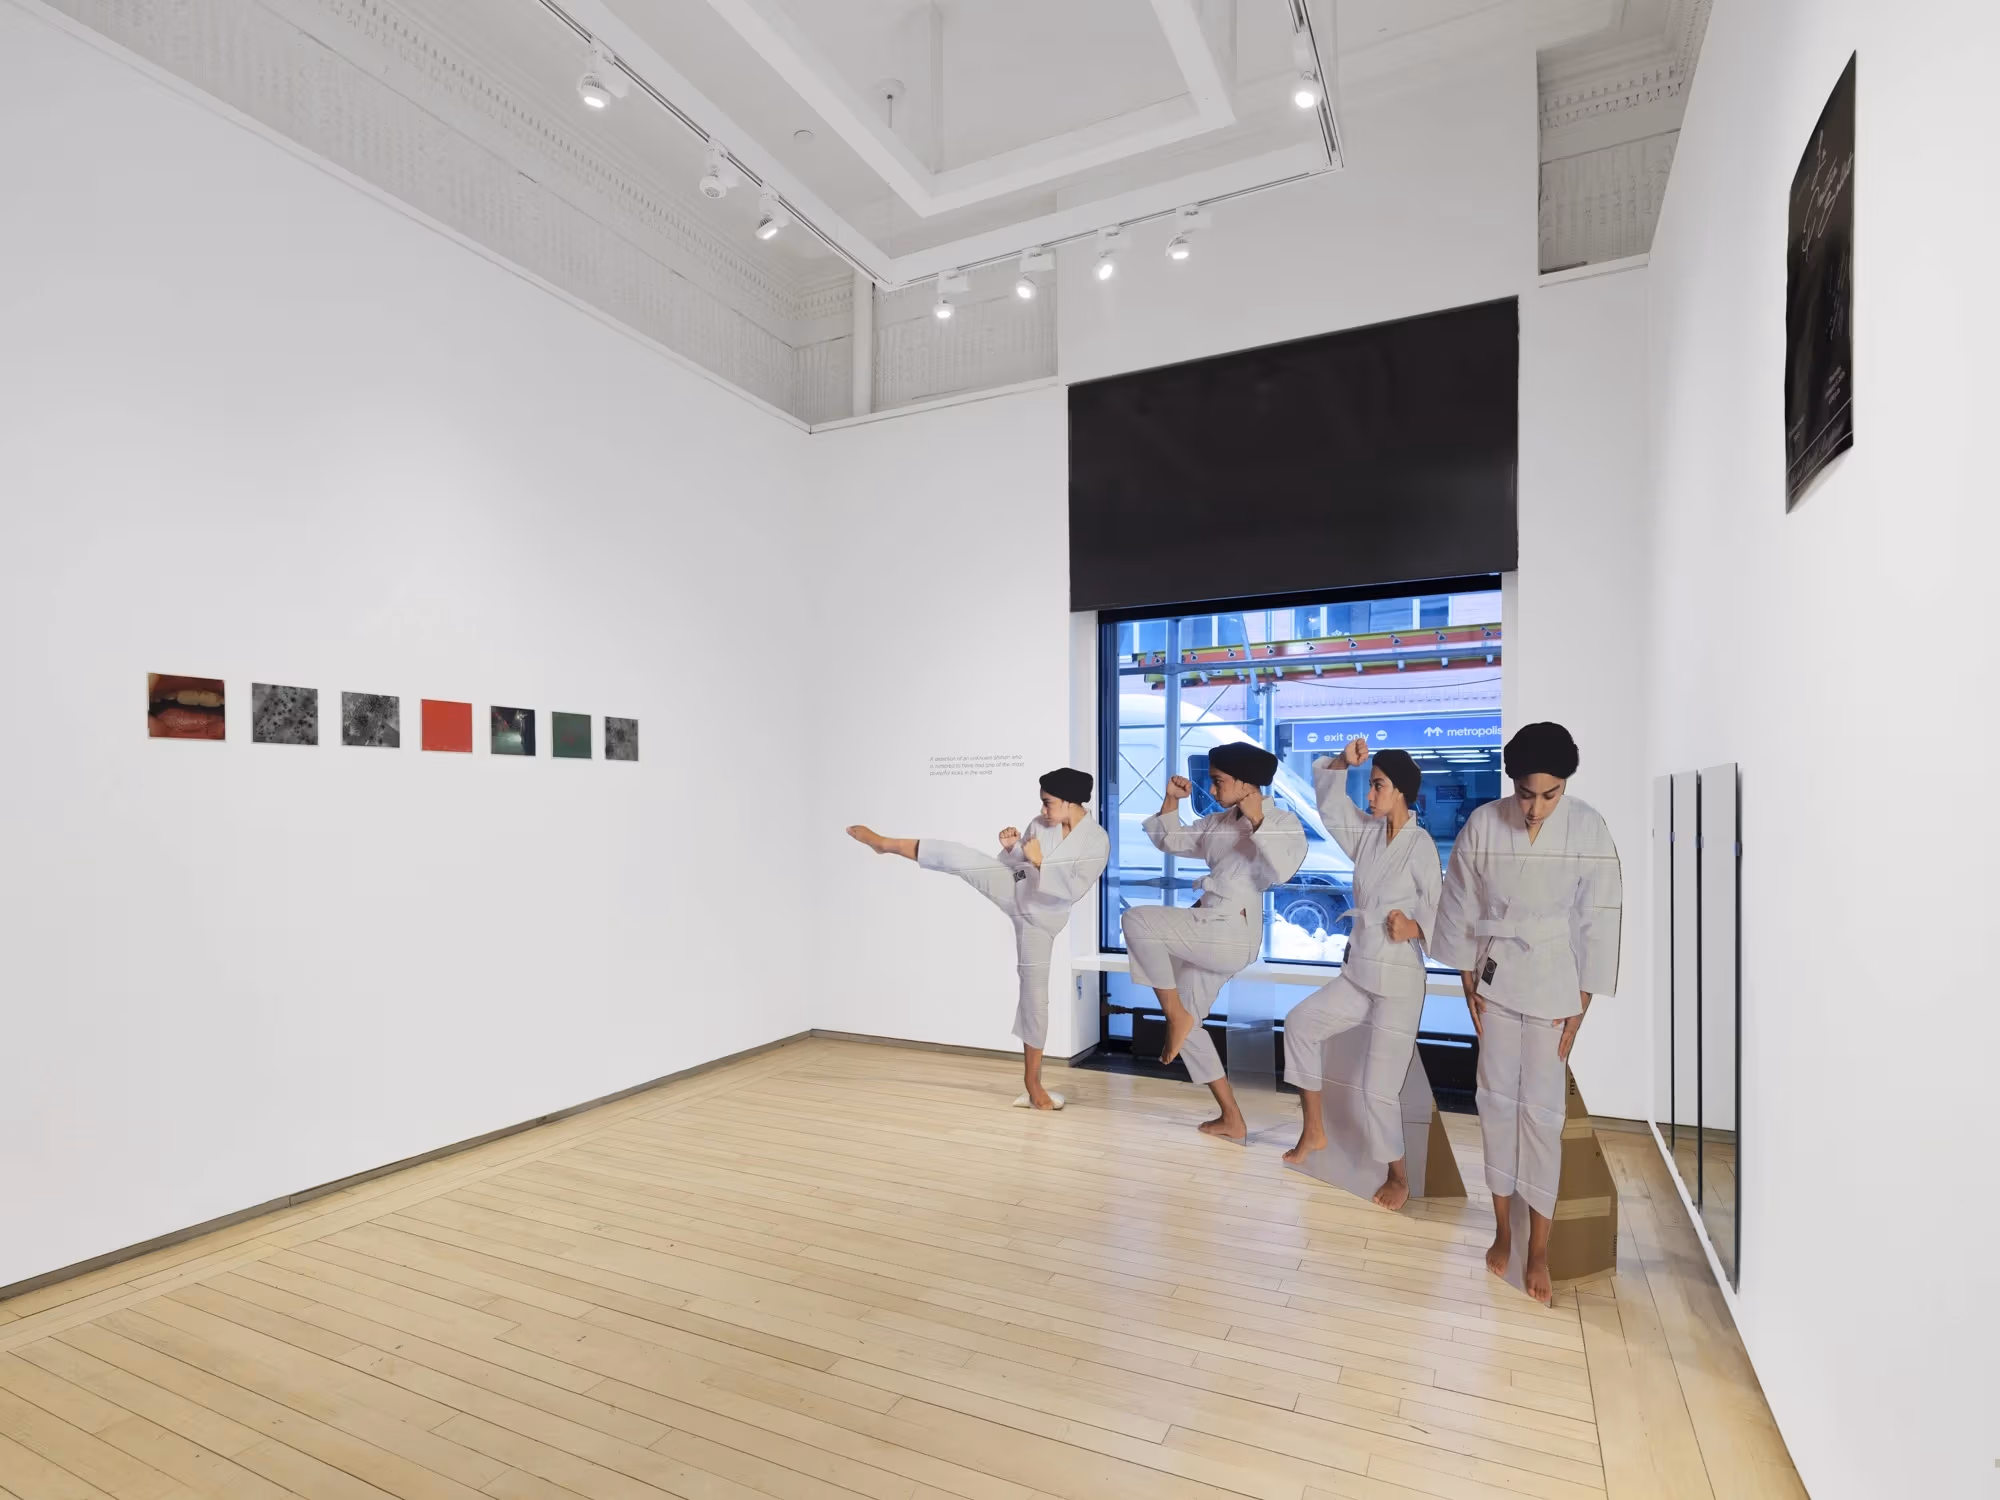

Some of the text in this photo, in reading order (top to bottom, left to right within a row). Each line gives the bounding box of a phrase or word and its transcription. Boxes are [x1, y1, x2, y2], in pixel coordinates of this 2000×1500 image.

[1447, 725, 1502, 737] metropolis
[1324, 732, 1370, 742] exit only
